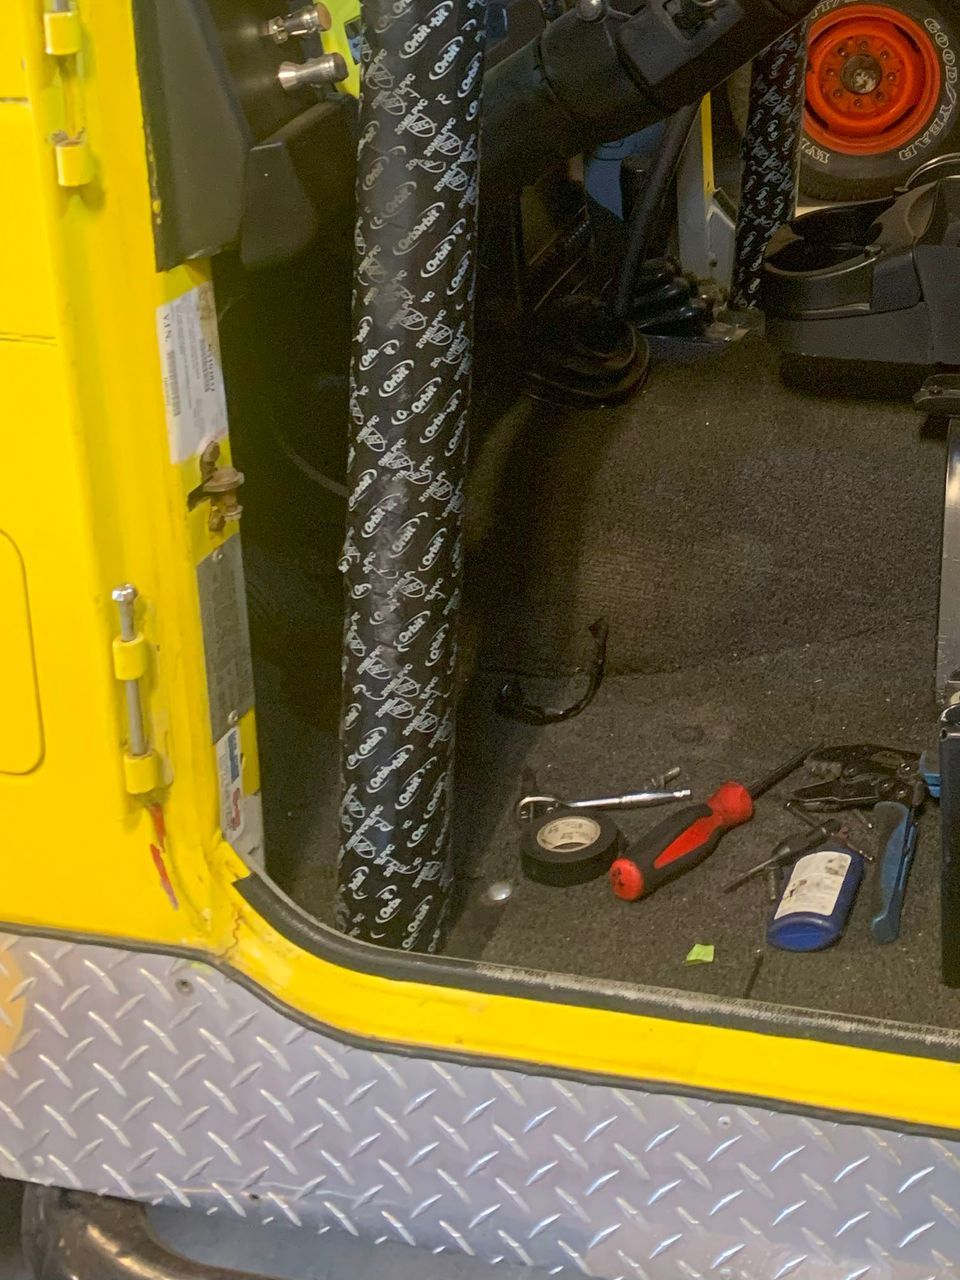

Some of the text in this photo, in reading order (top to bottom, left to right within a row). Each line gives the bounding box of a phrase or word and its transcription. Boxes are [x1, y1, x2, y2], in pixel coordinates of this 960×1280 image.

[404, 25, 431, 52] Orbit
[435, 43, 460, 73] Orbit
[462, 61, 479, 90] Orbit
[426, 243, 451, 270] Orbit
[383, 366, 409, 391] Orbit
[412, 385, 437, 412] Orbit
[365, 507, 385, 532] Orbit
[392, 525, 416, 551] Orbit
[423, 536, 444, 565] Orbit
[399, 618, 425, 641] Orbit
[360, 732, 382, 754] Orbit
[400, 777, 421, 803] Orbit
